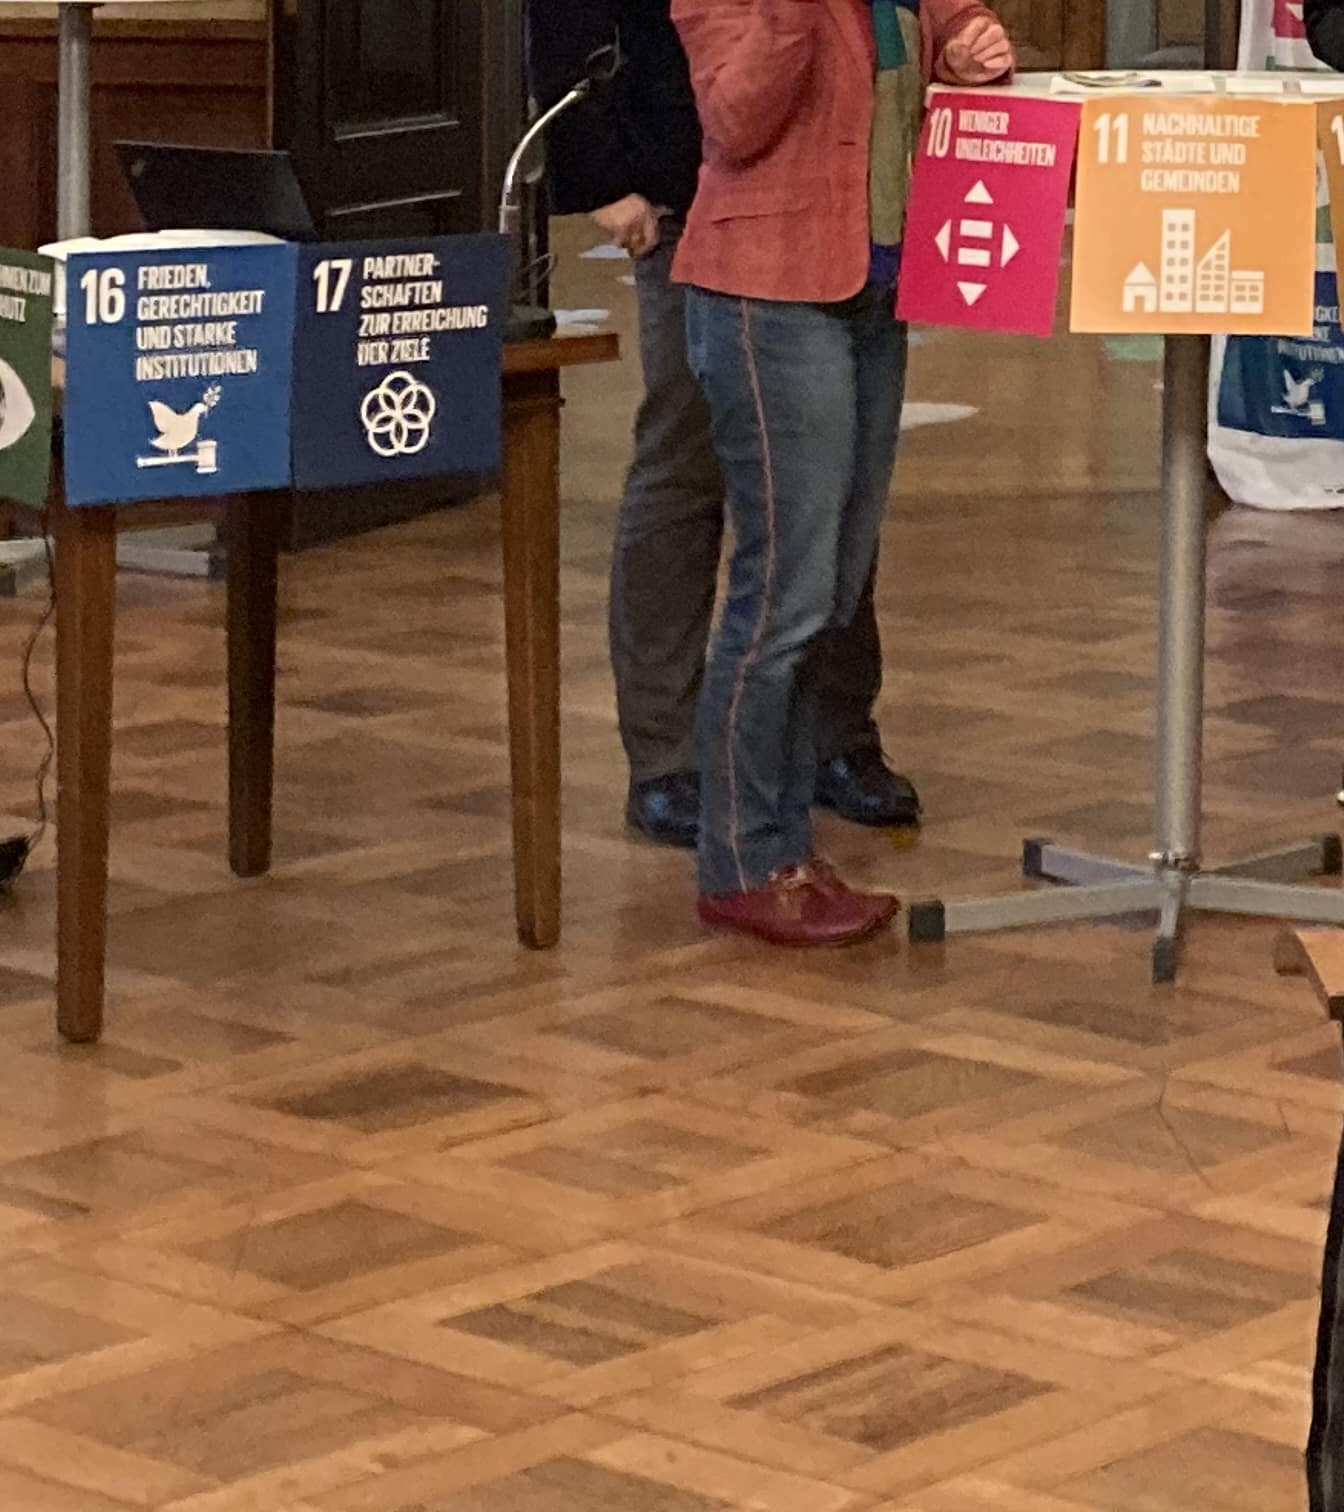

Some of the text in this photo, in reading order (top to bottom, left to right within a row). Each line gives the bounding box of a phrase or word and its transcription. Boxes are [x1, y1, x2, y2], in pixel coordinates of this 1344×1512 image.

[927, 107, 1009, 158] 10 WENIGER
[1093, 113, 1261, 163] 11 NACHHALTIGE
[955, 137, 1056, 166] UNGLEICHHEITEN
[1141, 138, 1246, 165] STÄDTE UND
[1141, 168, 1240, 193] GEMEINDEN
[80, 264, 211, 325] 16 FRIEDEN,
[313, 253, 440, 313] 17 PARTNER-
[360, 281, 442, 309] SCHAFTEN
[137, 290, 264, 321] GERECHTIGKEIT
[358, 305, 488, 337] ZUR ERREICHUNG
[136, 320, 238, 350] UND STARKE
[136, 349, 257, 381] INSTITUTIONEN
[357, 338, 431, 367] DER ZIELE
